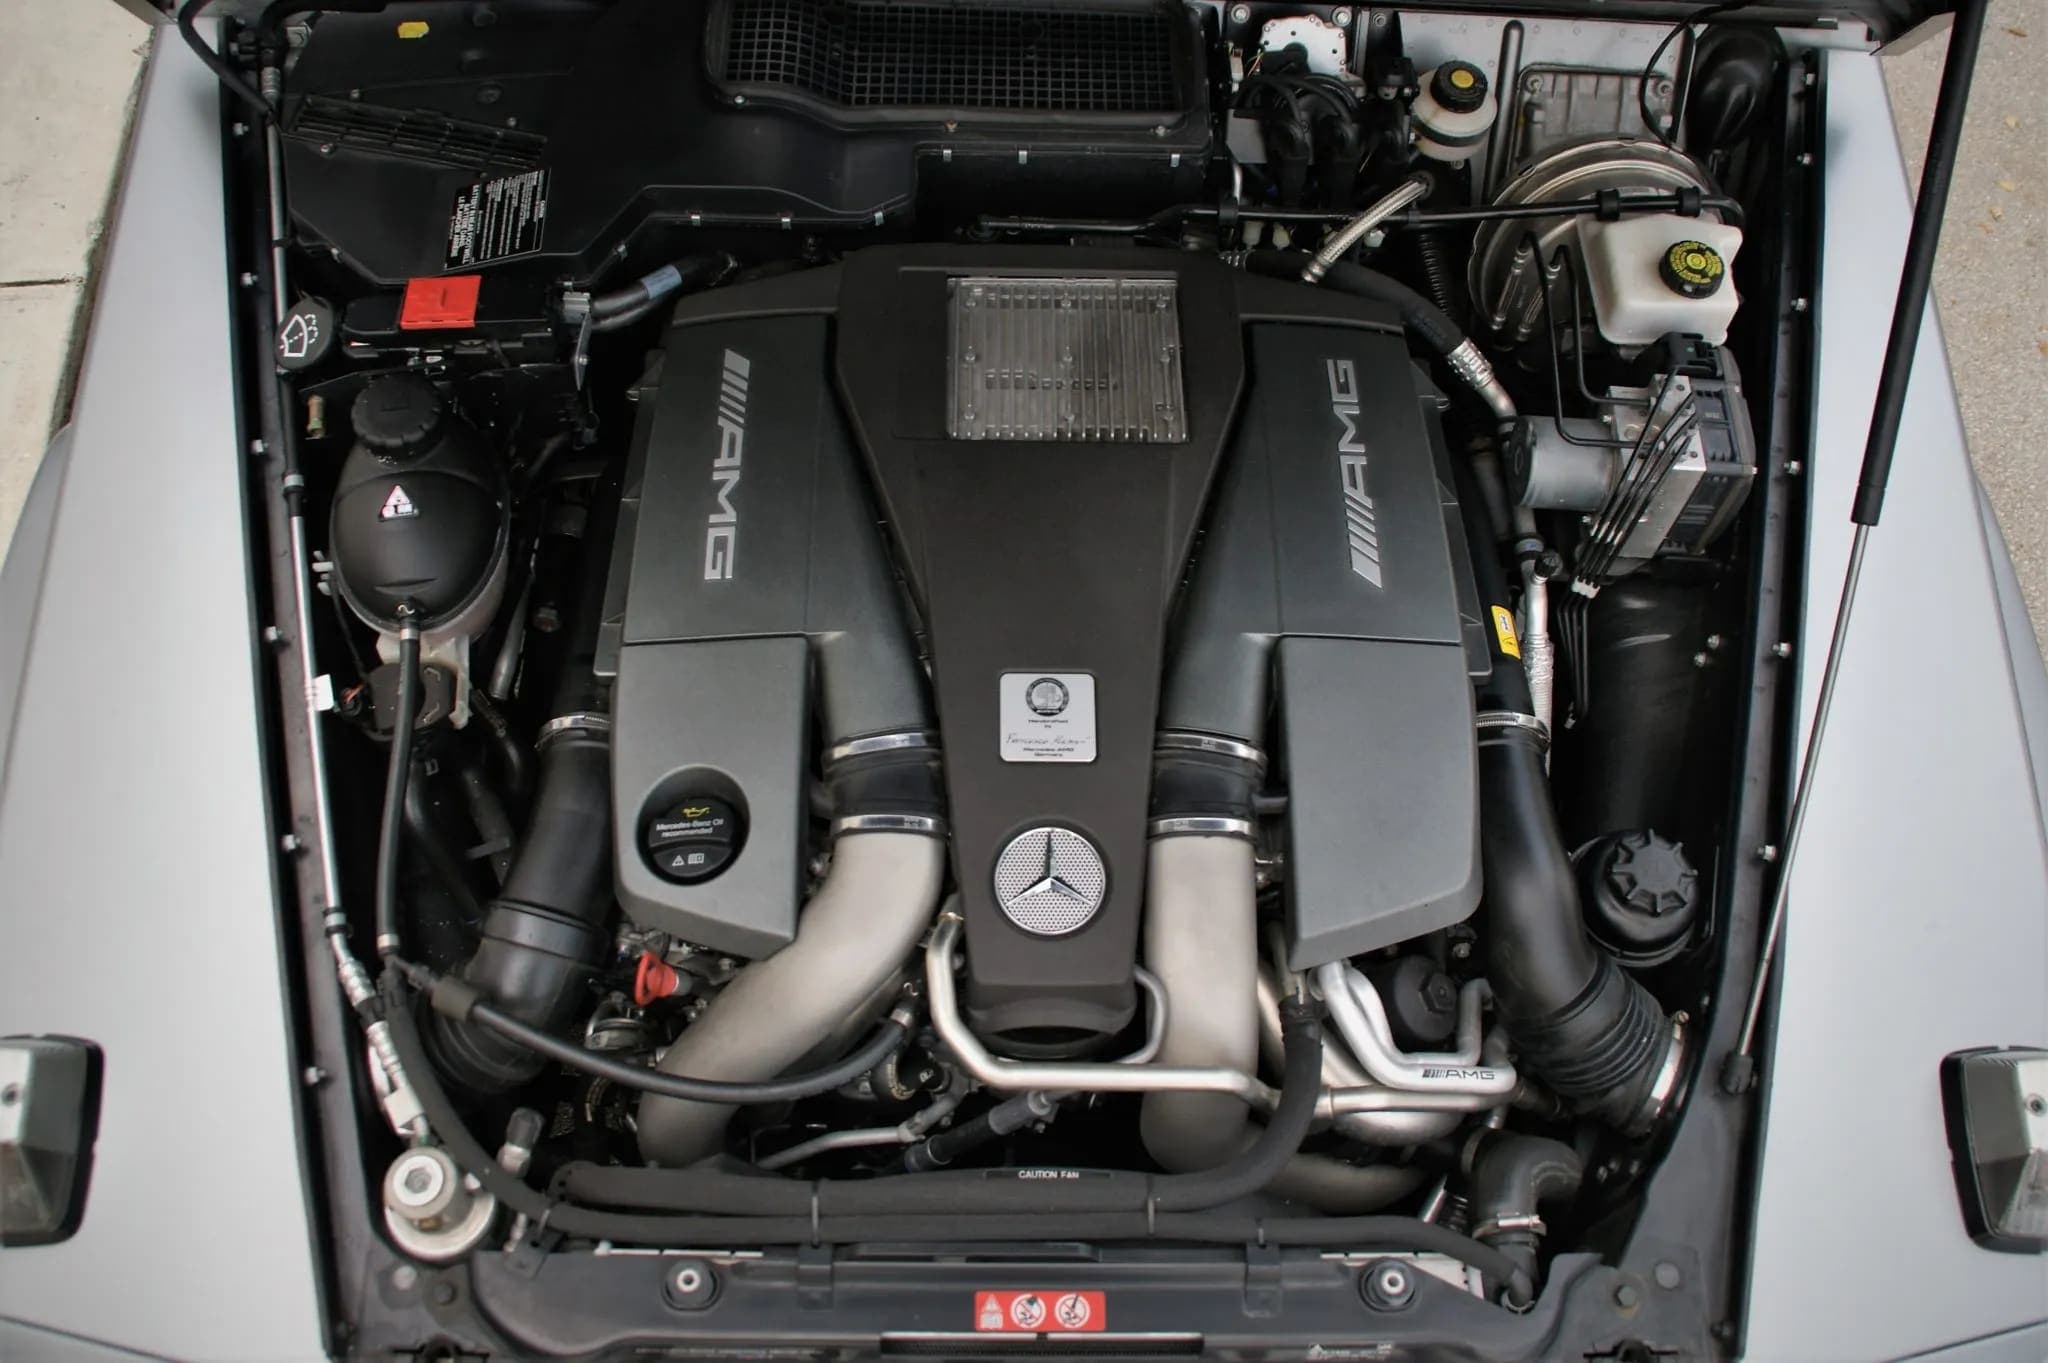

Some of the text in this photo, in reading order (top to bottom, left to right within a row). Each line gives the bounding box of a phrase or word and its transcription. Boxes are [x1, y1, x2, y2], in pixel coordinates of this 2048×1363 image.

[1327, 359, 1368, 506] AMG
[704, 412, 744, 580] AMG
[656, 820, 711, 831] Mercedes-Benz
[661, 827, 713, 837] recommended
[1445, 1069, 1495, 1080] AMG
[1018, 1170, 1080, 1178] CAUTION FAN
